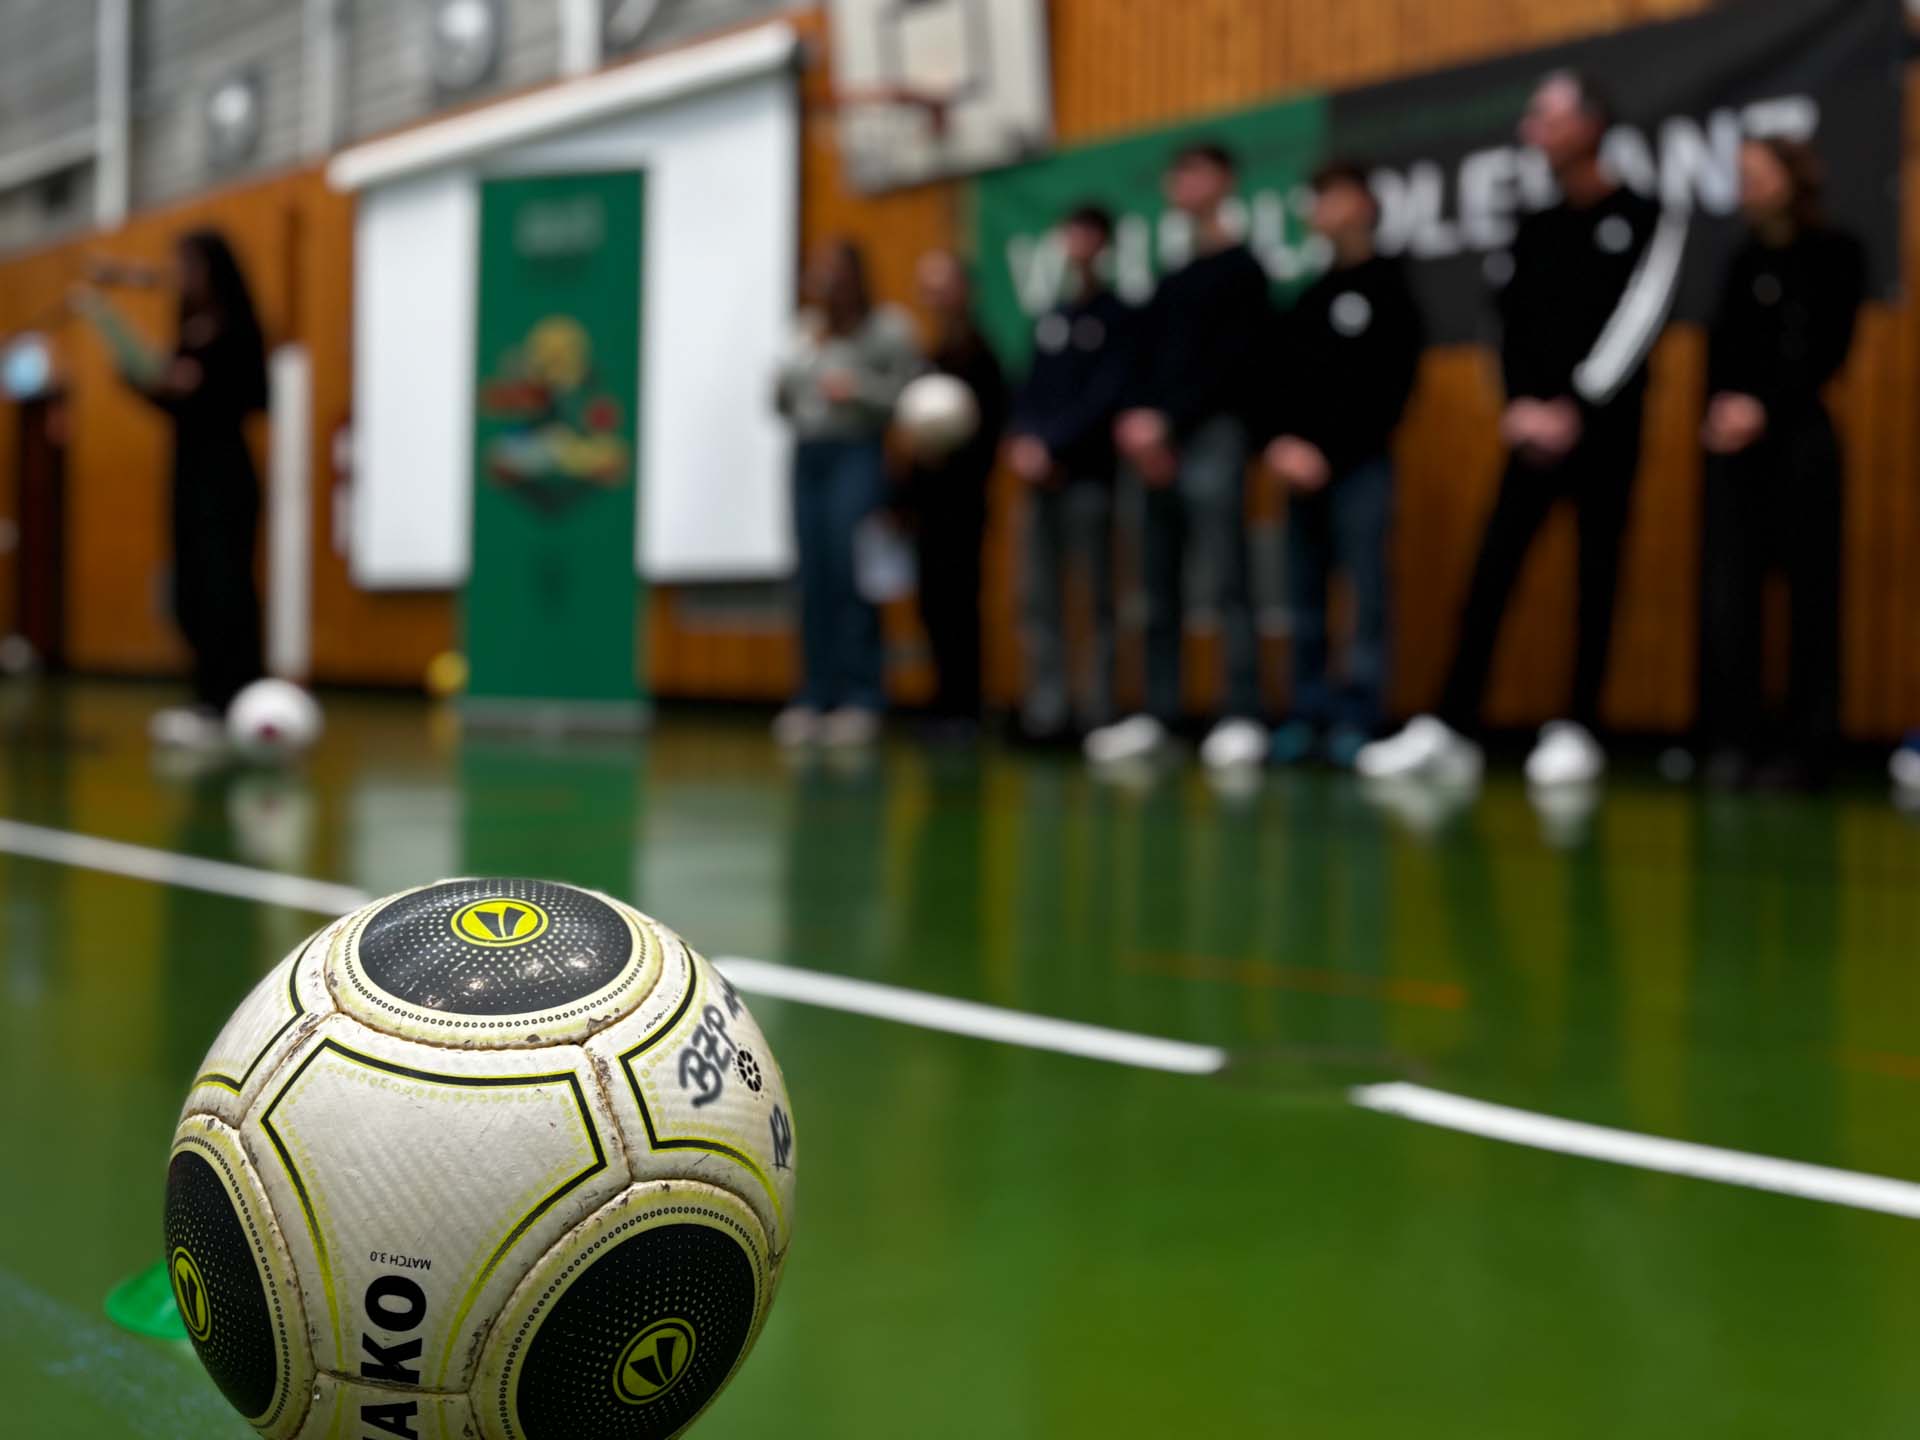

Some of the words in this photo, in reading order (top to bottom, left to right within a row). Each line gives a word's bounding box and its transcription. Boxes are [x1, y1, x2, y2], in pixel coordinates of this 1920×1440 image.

[369, 1250, 388, 1264] 3.0
[389, 1255, 432, 1271] MATCH
[360, 1275, 427, 1440] AKO
